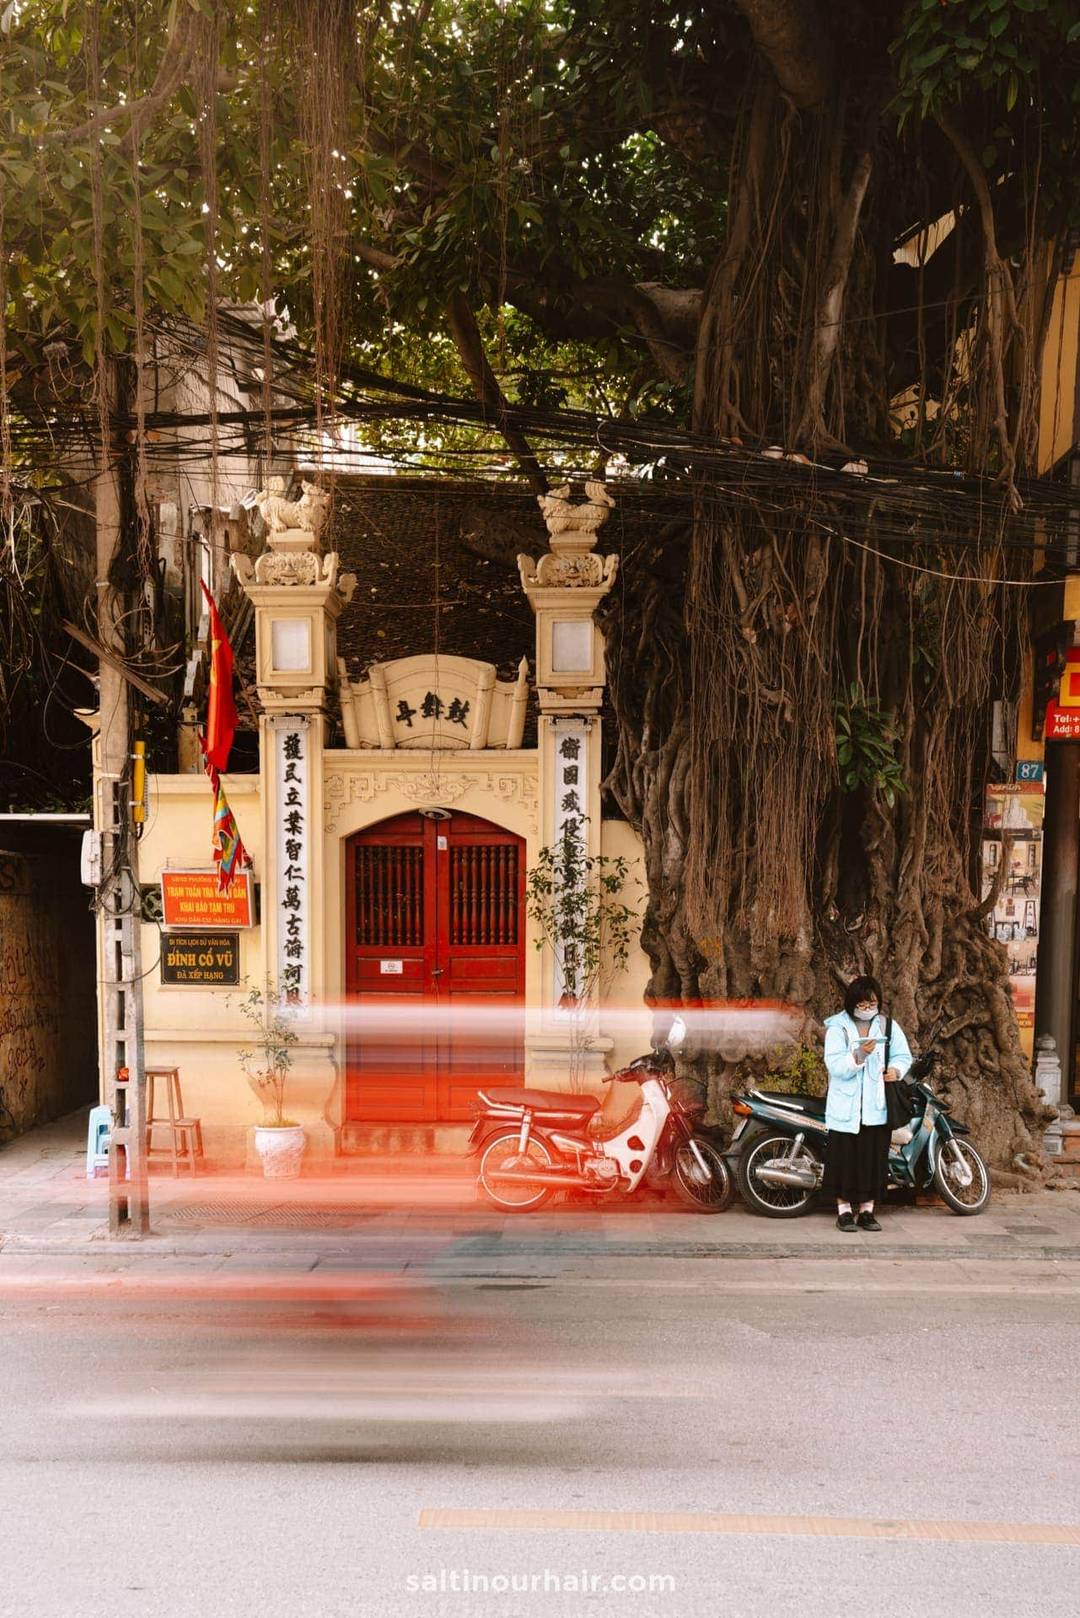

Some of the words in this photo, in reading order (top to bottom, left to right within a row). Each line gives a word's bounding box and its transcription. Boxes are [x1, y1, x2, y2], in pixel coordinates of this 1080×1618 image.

[1053, 725, 1073, 734] Add:
[1021, 763, 1039, 778] 87
[167, 949, 196, 966] ĐÌNH
[199, 947, 214, 967] CỔ
[216, 950, 233, 967] VŨ
[188, 968, 203, 979] XẾP
[203, 971, 224, 981] HẠNG
